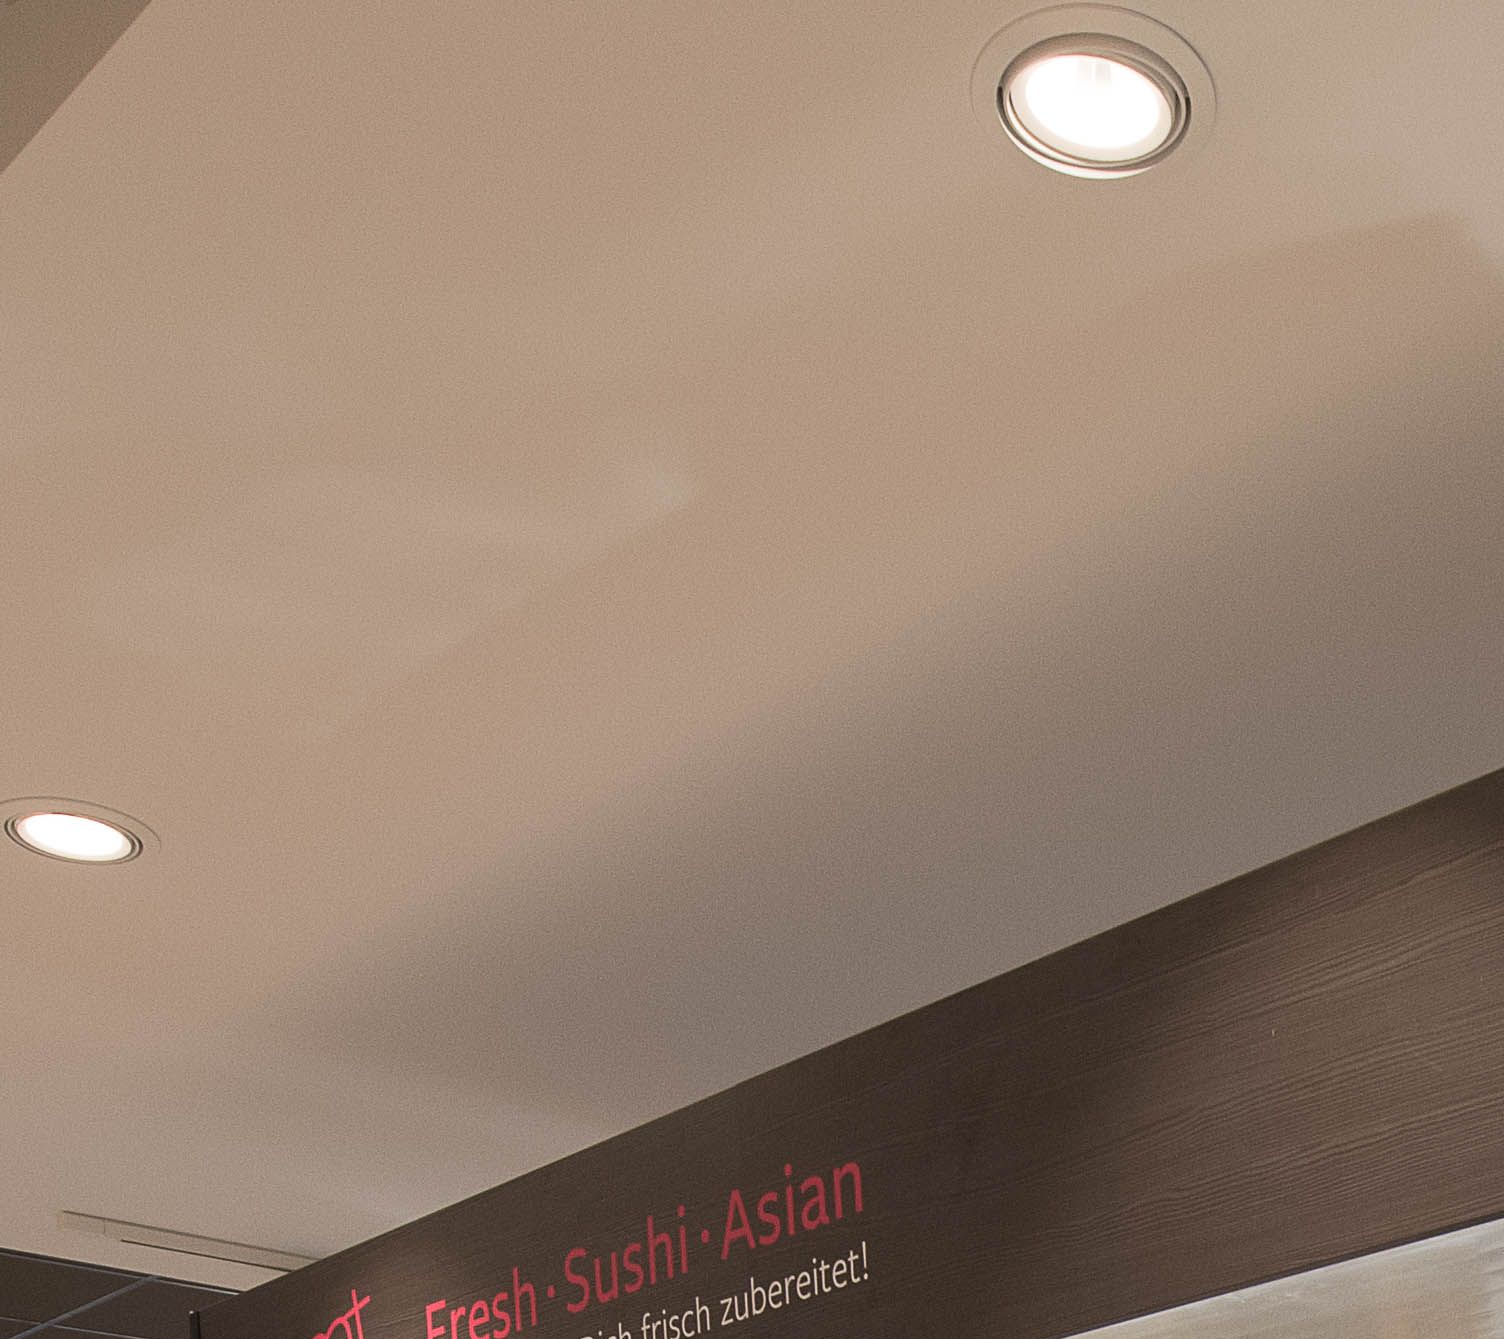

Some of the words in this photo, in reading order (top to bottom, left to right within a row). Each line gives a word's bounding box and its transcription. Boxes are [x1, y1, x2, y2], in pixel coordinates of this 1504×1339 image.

[564, 1206, 689, 1314] Sushi
[720, 1161, 865, 1260] Asian
[720, 1240, 870, 1327] zubereitet!
